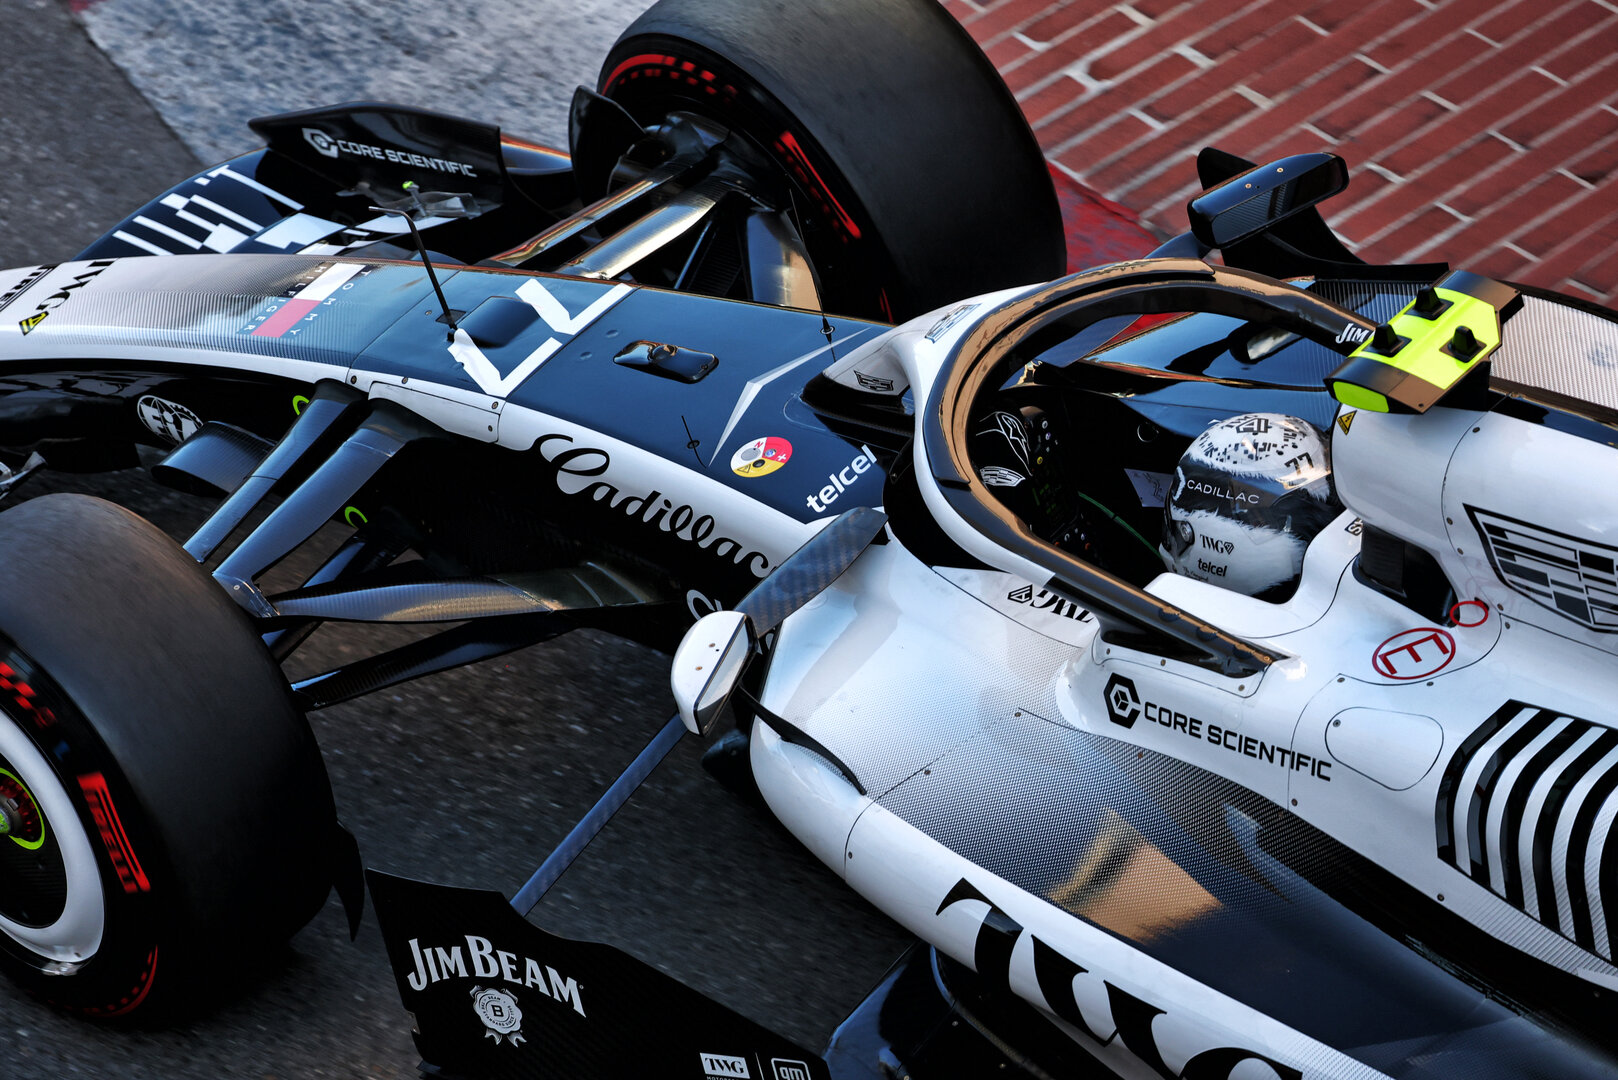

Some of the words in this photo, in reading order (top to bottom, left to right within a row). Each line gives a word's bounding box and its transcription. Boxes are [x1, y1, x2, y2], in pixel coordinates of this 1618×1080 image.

[336, 140, 385, 160] CORE
[384, 149, 478, 178] SCIENTIFIC
[243, 265, 328, 331] HILFIGER
[290, 270, 372, 336] TOMMY
[1335, 322, 1370, 344] JIM
[806, 444, 878, 513] telcel
[1187, 479, 1260, 504] CADILLAC
[528, 433, 777, 578] Cadillac
[1197, 557, 1228, 577] telcel
[1200, 534, 1225, 554] TWG
[1144, 701, 1203, 740] CORE
[1207, 724, 1332, 782] SCIENTIFIC
[407, 938, 470, 991] JIM
[464, 934, 587, 1018] BEAM
[705, 1057, 745, 1074] TWG
